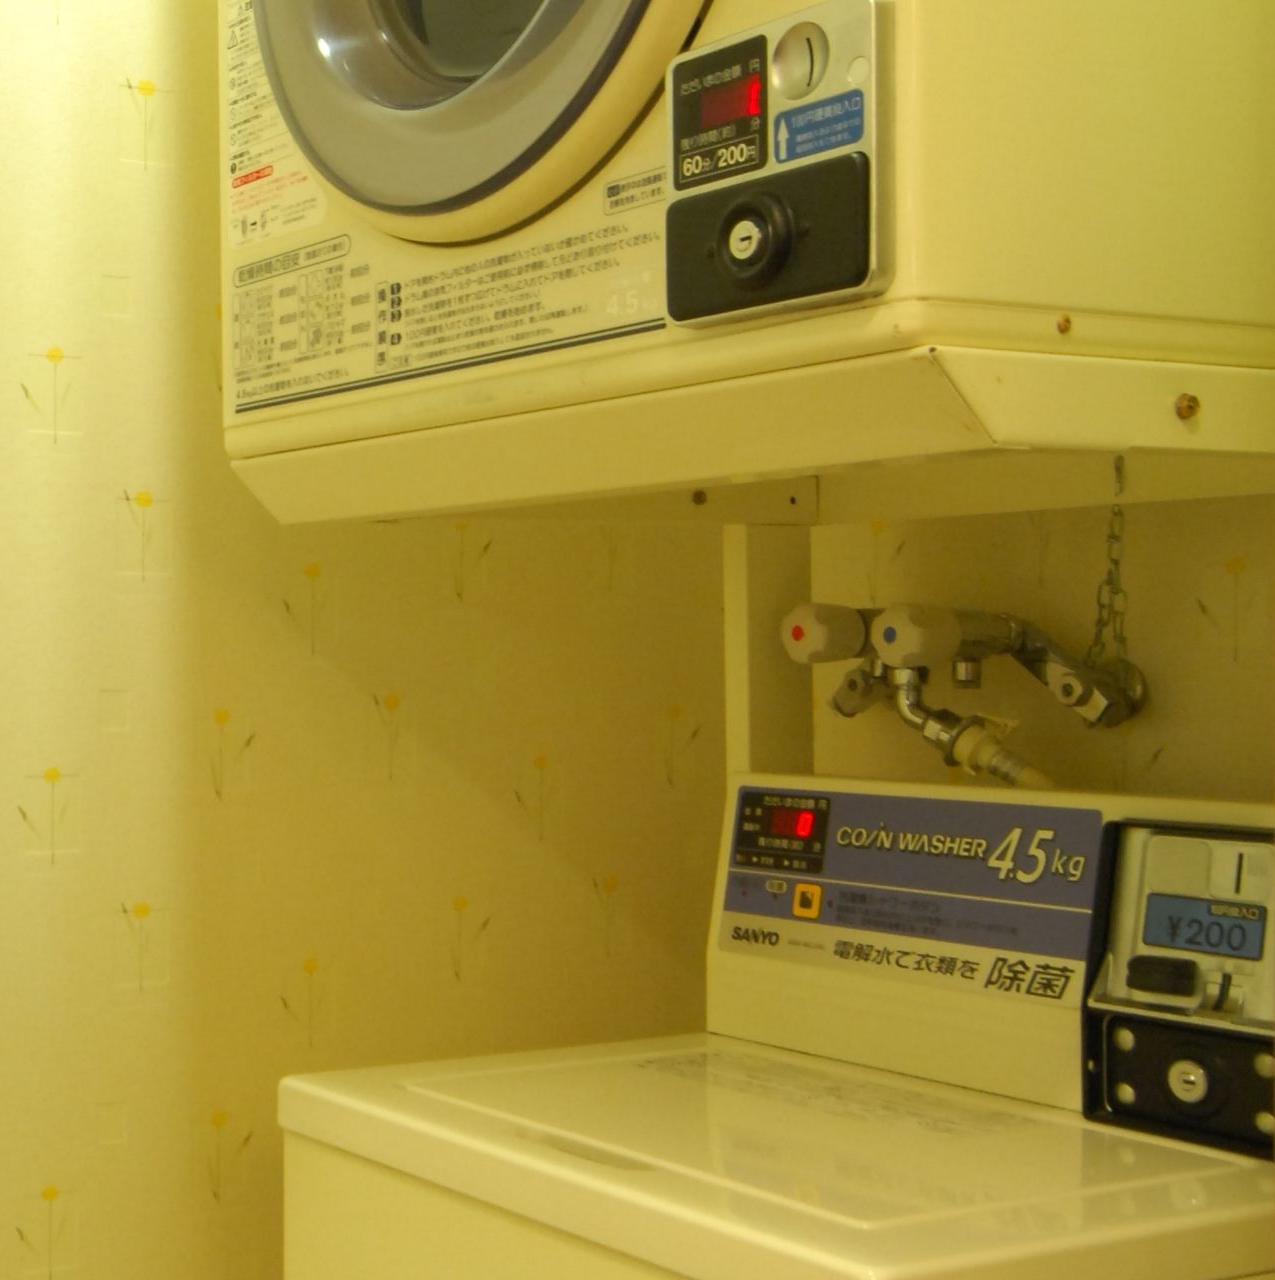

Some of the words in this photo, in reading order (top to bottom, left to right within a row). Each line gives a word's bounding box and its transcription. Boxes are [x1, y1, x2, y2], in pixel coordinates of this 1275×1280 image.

[796, 811, 815, 838] 0
[898, 831, 988, 858] WASHER
[1167, 915, 1247, 951] ¥200
[731, 926, 779, 946] SANYO
[833, 938, 981, 981] 電解水で衣類を
[984, 946, 1076, 1000] 除菌
